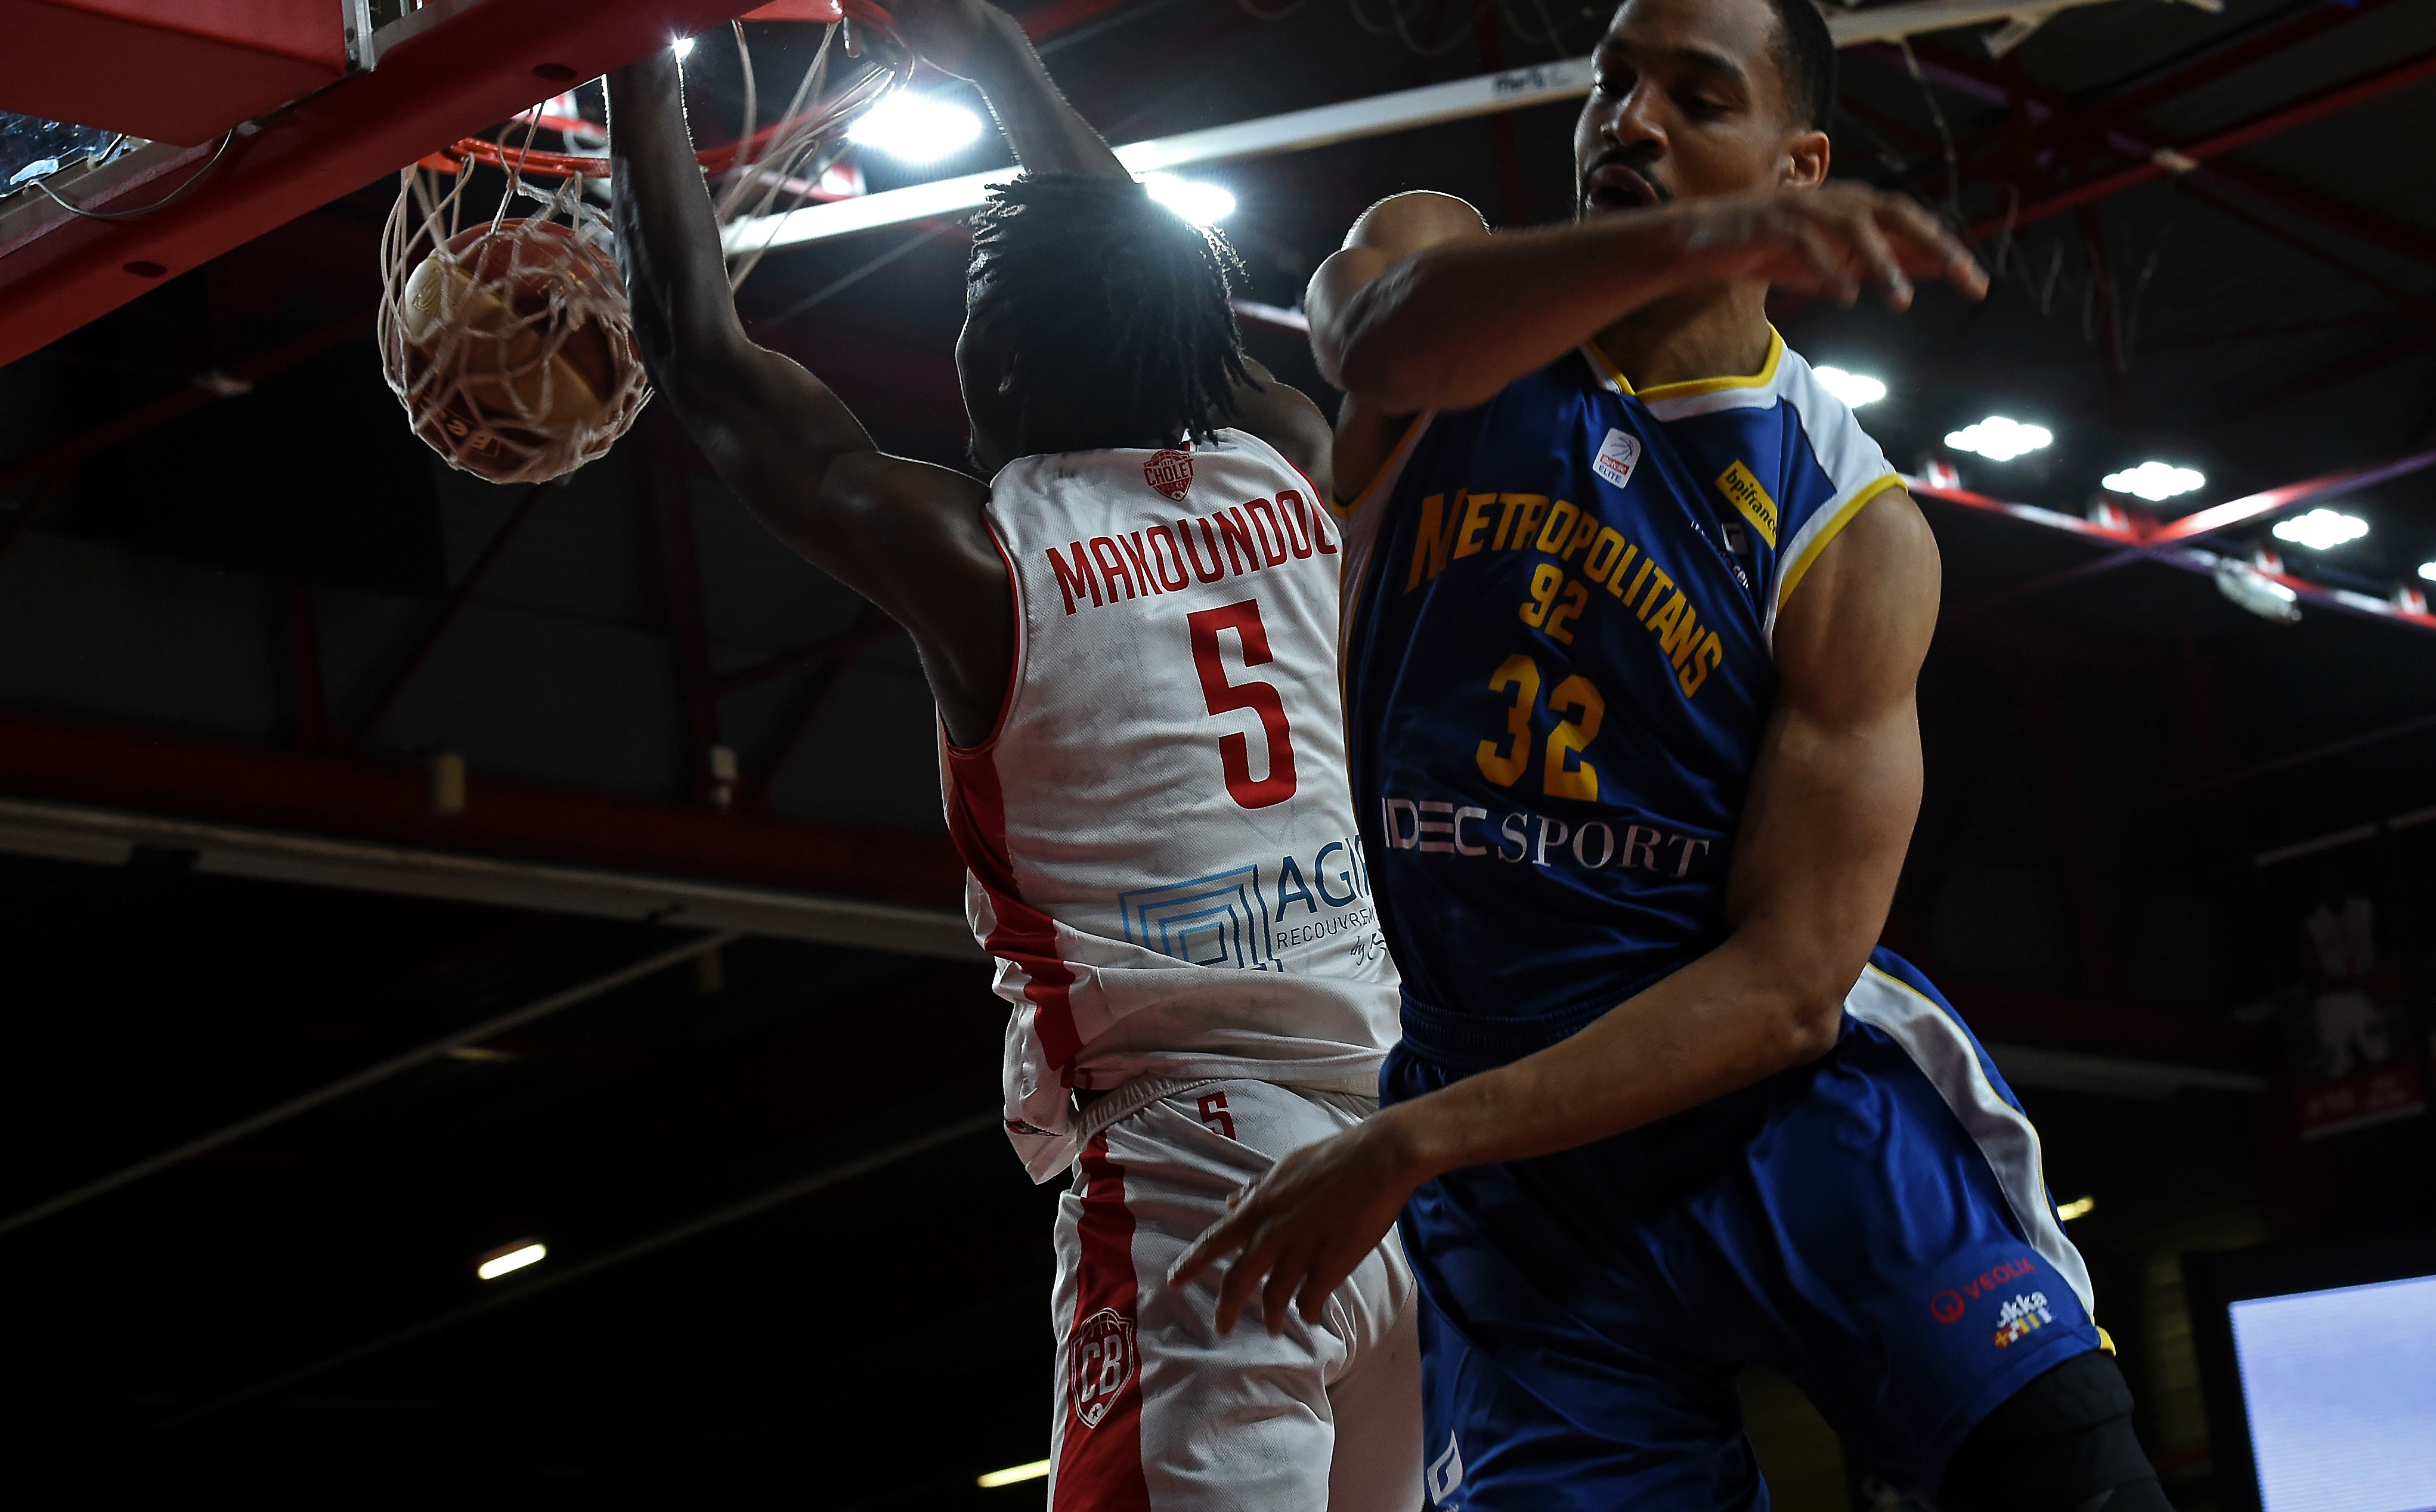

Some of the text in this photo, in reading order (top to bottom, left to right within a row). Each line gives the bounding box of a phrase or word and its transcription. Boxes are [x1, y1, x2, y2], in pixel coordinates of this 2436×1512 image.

[1144, 457, 1193, 486] CHOLET
[1598, 464, 1621, 483] ELITE
[1403, 488, 1723, 699] METROPOLITANS
[1519, 563, 1588, 646] 92
[1187, 598, 1297, 810] 5
[1476, 653, 1606, 803] 32
[1381, 797, 1710, 879] IDEC SPORT
[1197, 1090, 1236, 1141] 5
[1962, 1256, 2037, 1299] VEOLIA
[1081, 1333, 1123, 1403] CB
